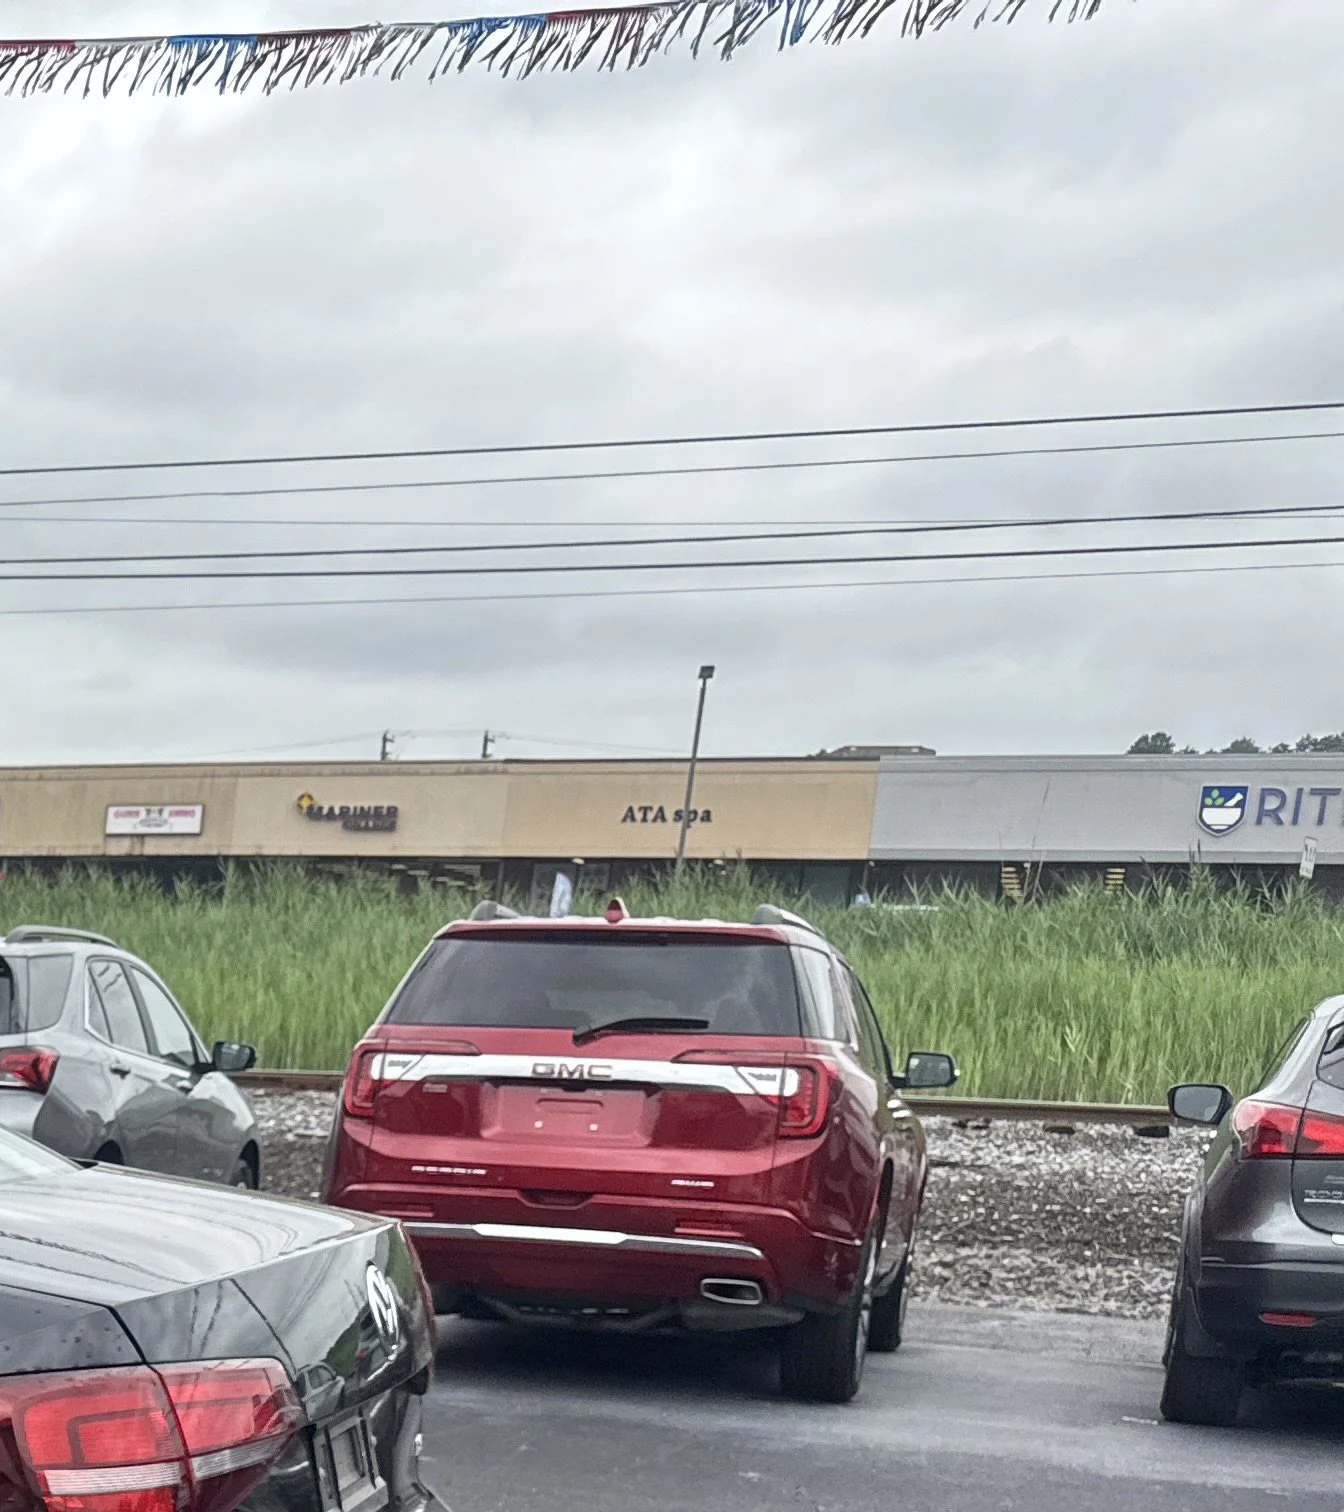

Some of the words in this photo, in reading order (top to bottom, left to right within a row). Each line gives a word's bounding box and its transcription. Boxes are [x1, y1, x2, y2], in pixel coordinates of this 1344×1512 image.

[307, 804, 398, 821] MARINER
[1255, 787, 1344, 826] RIT
[620, 805, 668, 823] ATA
[673, 807, 712, 829] spa
[532, 1062, 613, 1079] GMC
